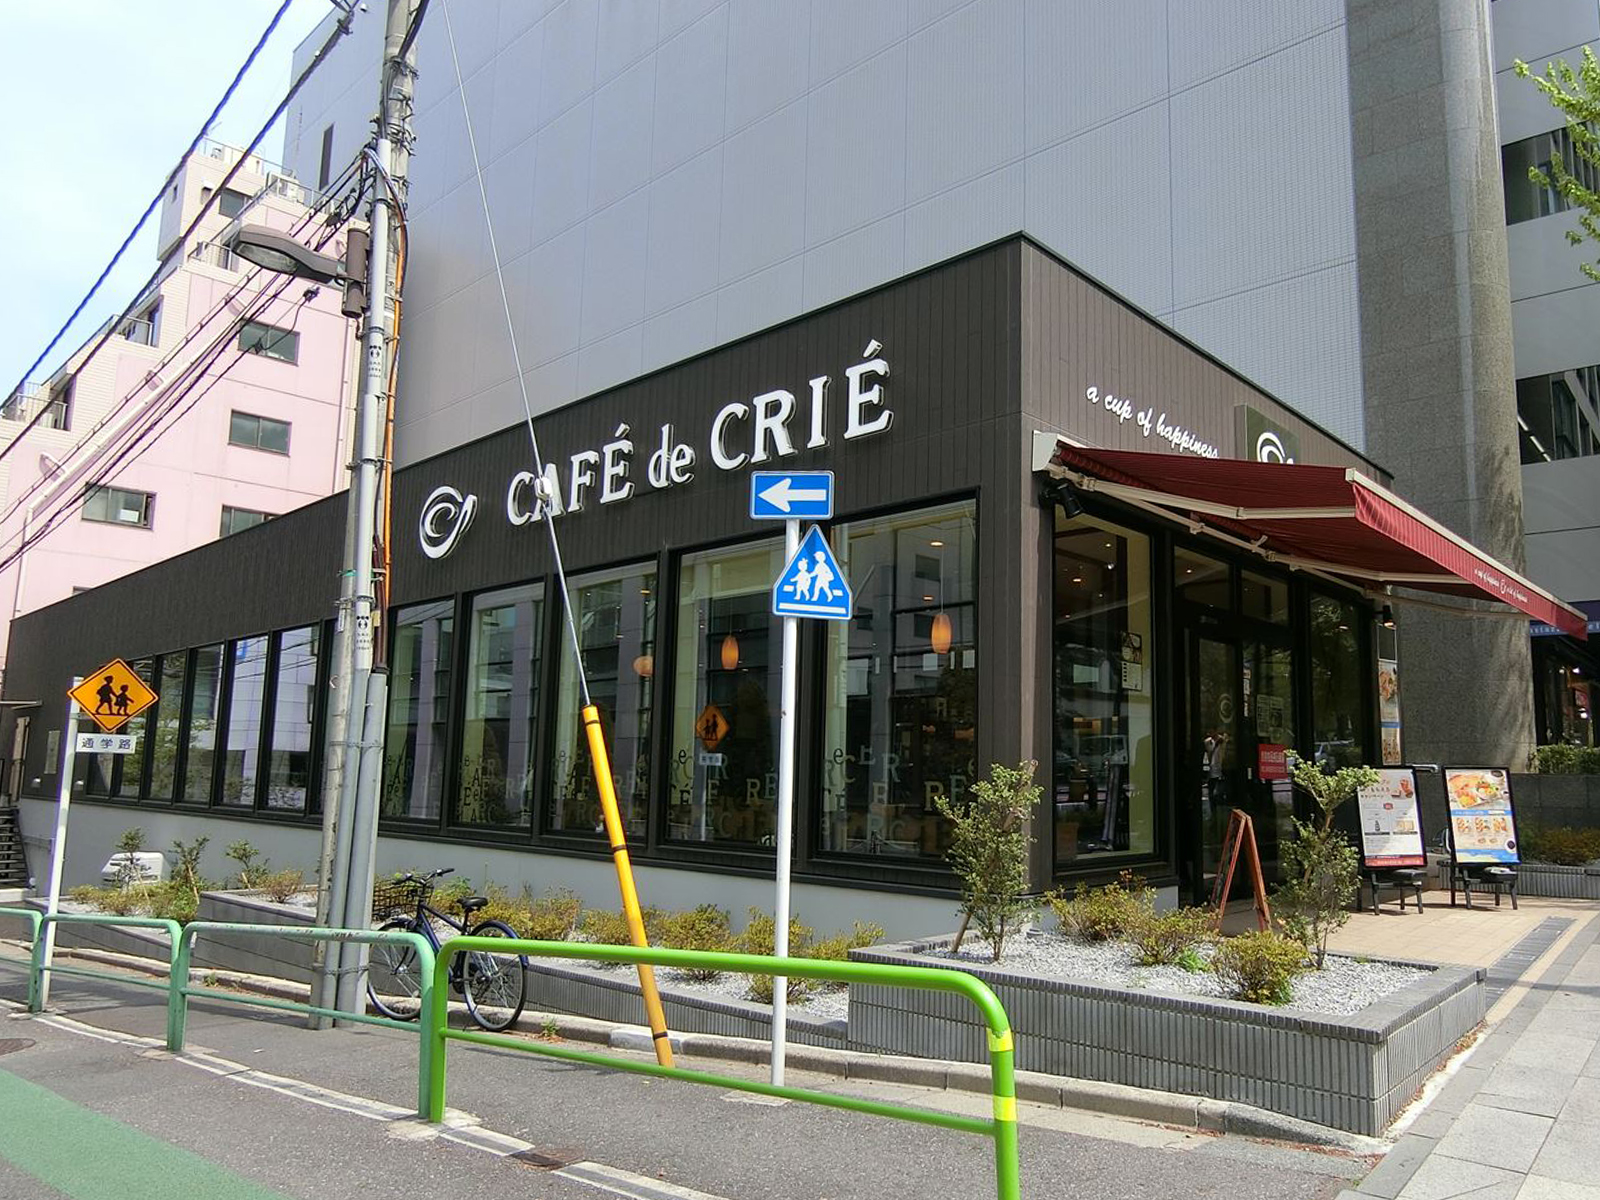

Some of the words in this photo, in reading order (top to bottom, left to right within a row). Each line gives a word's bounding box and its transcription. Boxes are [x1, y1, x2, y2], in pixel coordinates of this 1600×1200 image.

[508, 423, 635, 526] CAFÉ
[648, 424, 695, 488] de
[711, 339, 894, 470] CRIÉ
[1086, 386, 1099, 403] a
[1104, 394, 1133, 424] cup
[1137, 407, 1153, 437] of
[82, 738, 131, 749] 通学路
